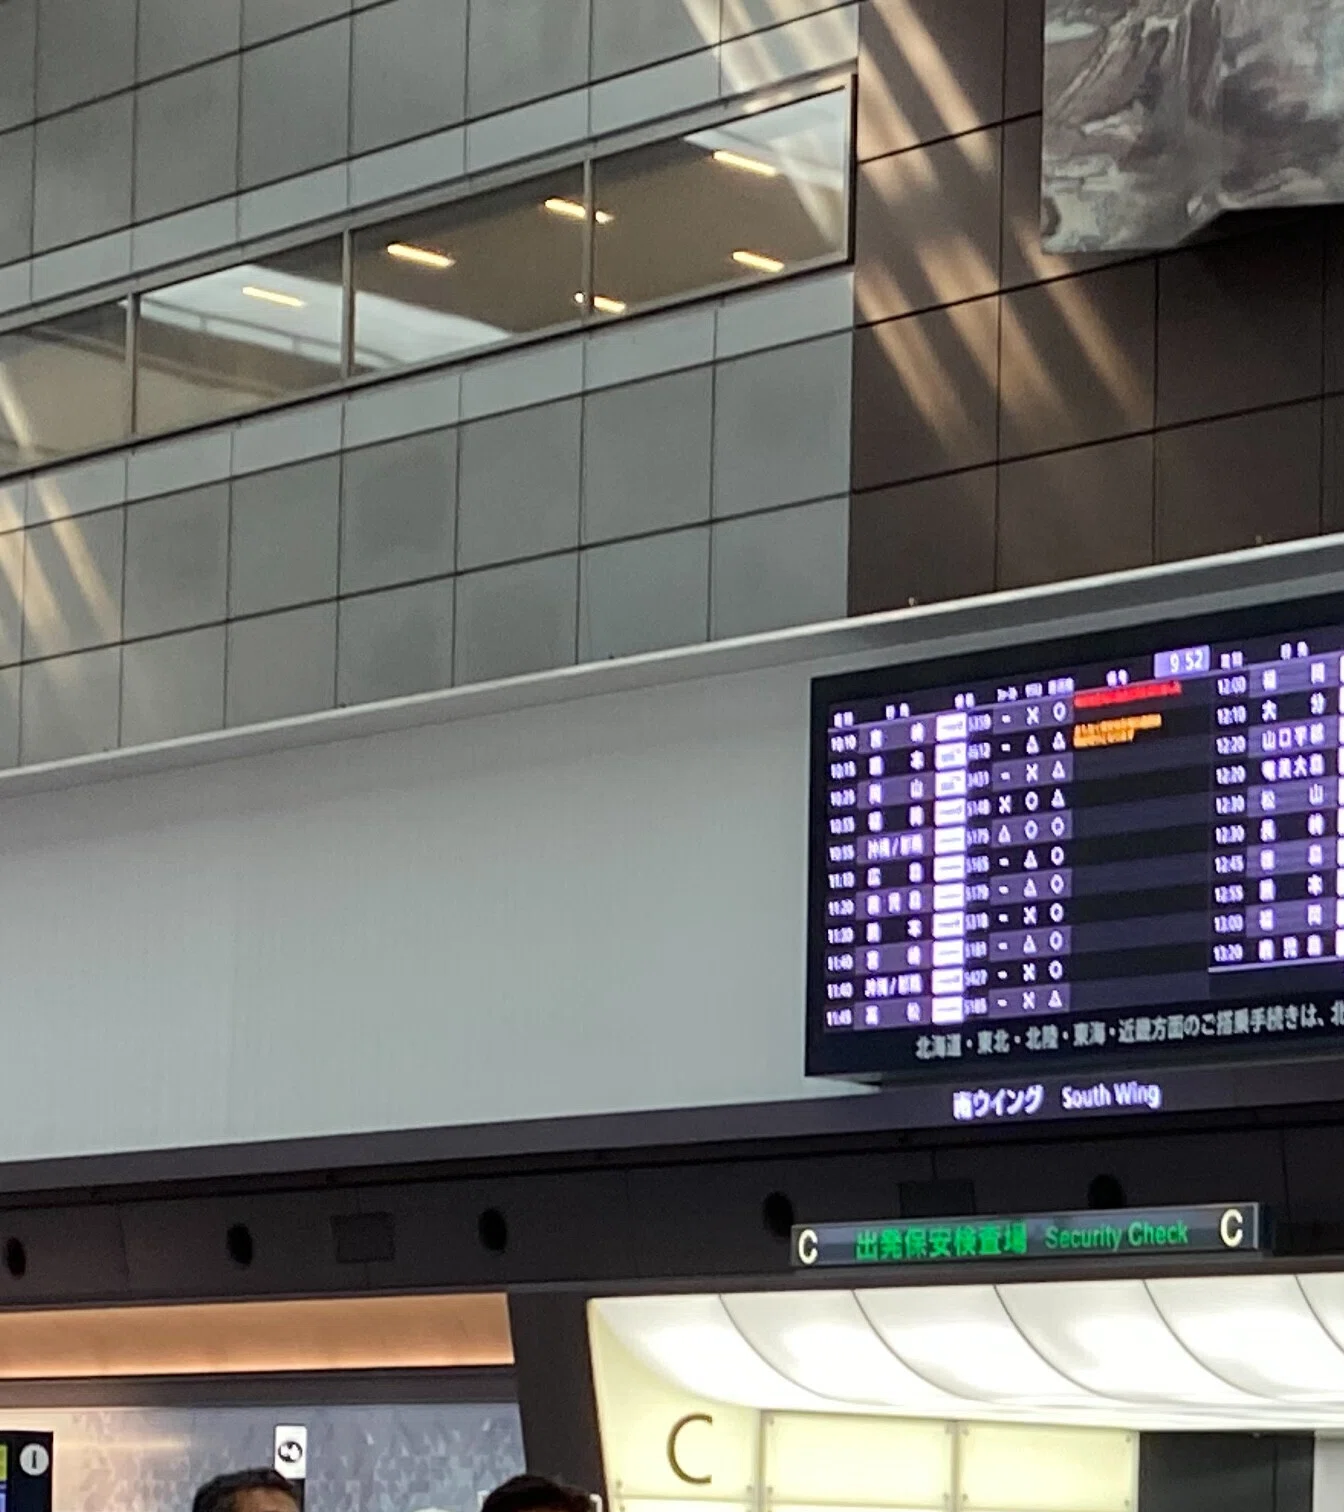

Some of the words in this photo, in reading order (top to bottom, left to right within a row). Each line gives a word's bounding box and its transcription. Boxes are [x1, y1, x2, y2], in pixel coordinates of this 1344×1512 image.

[1062, 1082, 1112, 1110] South
[1113, 1080, 1162, 1110] Wing
[797, 1228, 819, 1265] C
[855, 1222, 1027, 1262] 出発保安検査場
[1045, 1225, 1122, 1252] Security
[1128, 1219, 1190, 1248] Check
[1220, 1208, 1244, 1247] C
[667, 1413, 714, 1486] C
